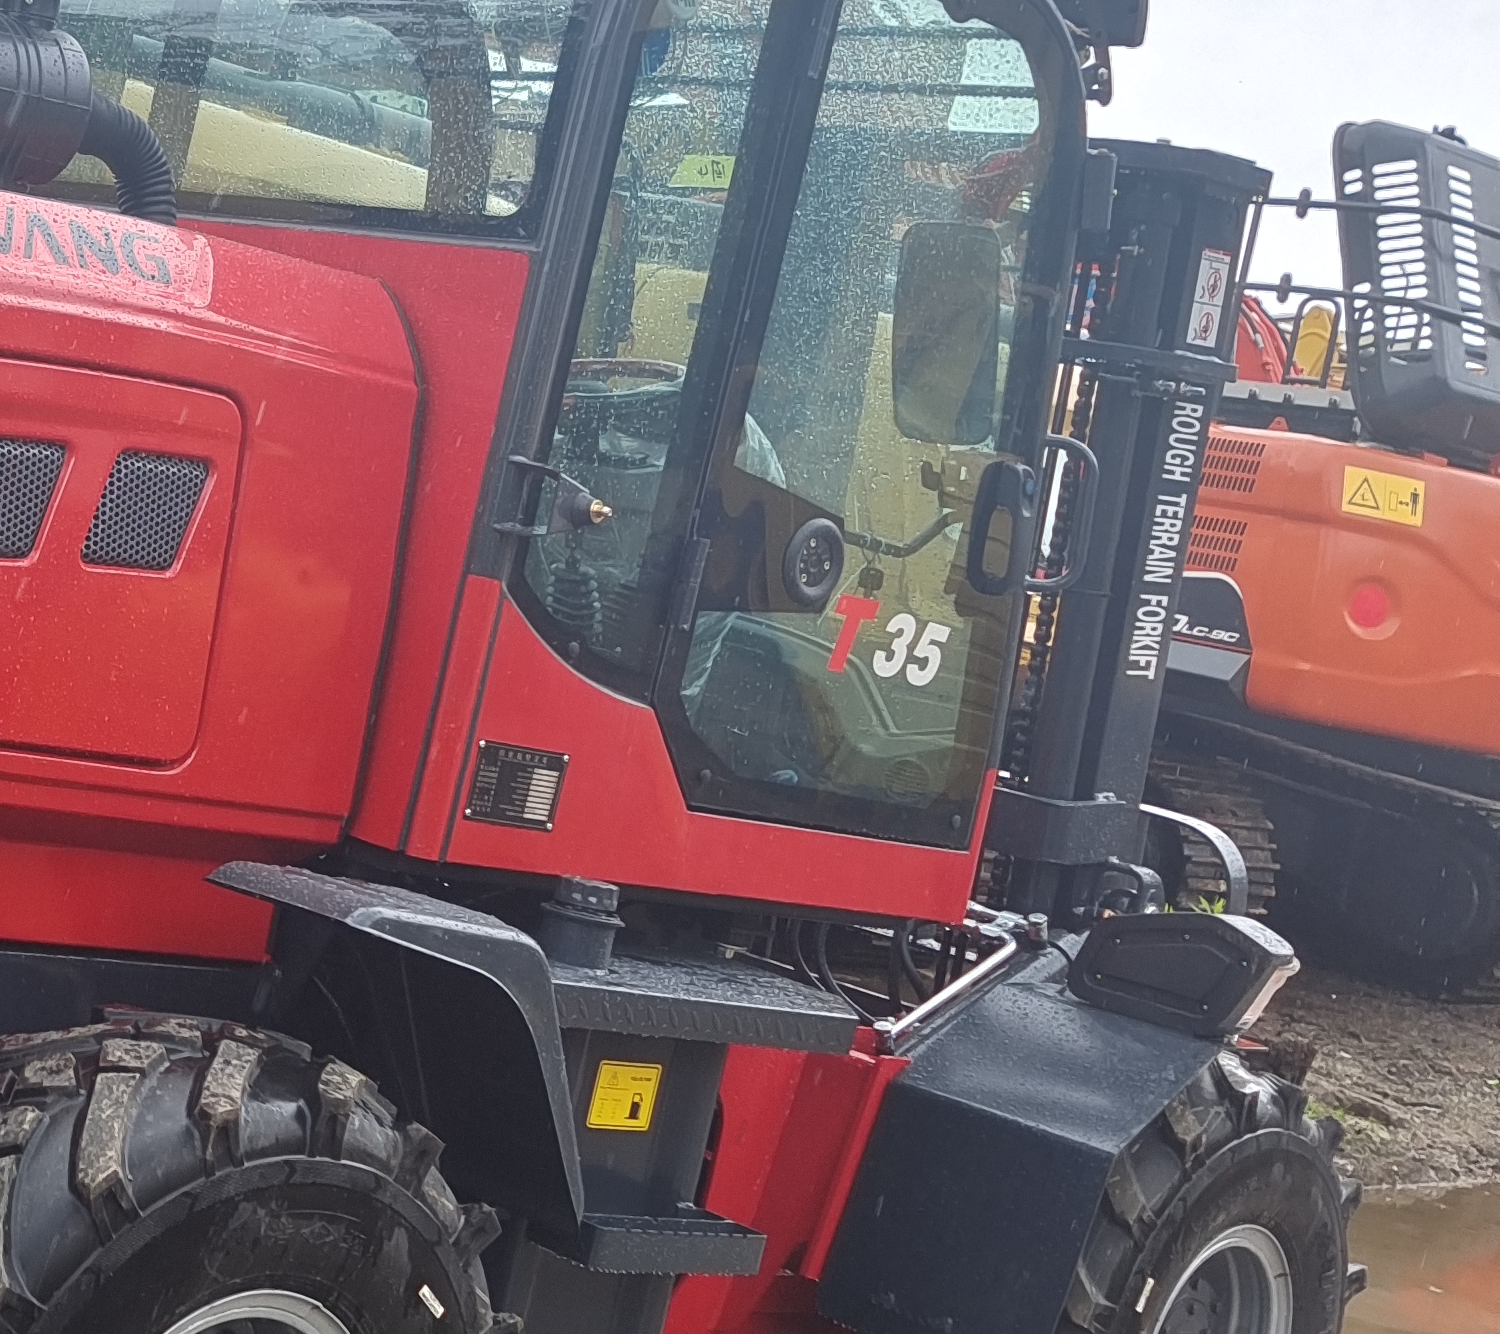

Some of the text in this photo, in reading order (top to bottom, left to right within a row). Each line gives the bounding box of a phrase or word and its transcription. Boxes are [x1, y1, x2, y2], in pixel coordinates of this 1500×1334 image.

[1125, 400, 1204, 680] ROUGH TERRAIN FORKIFT
